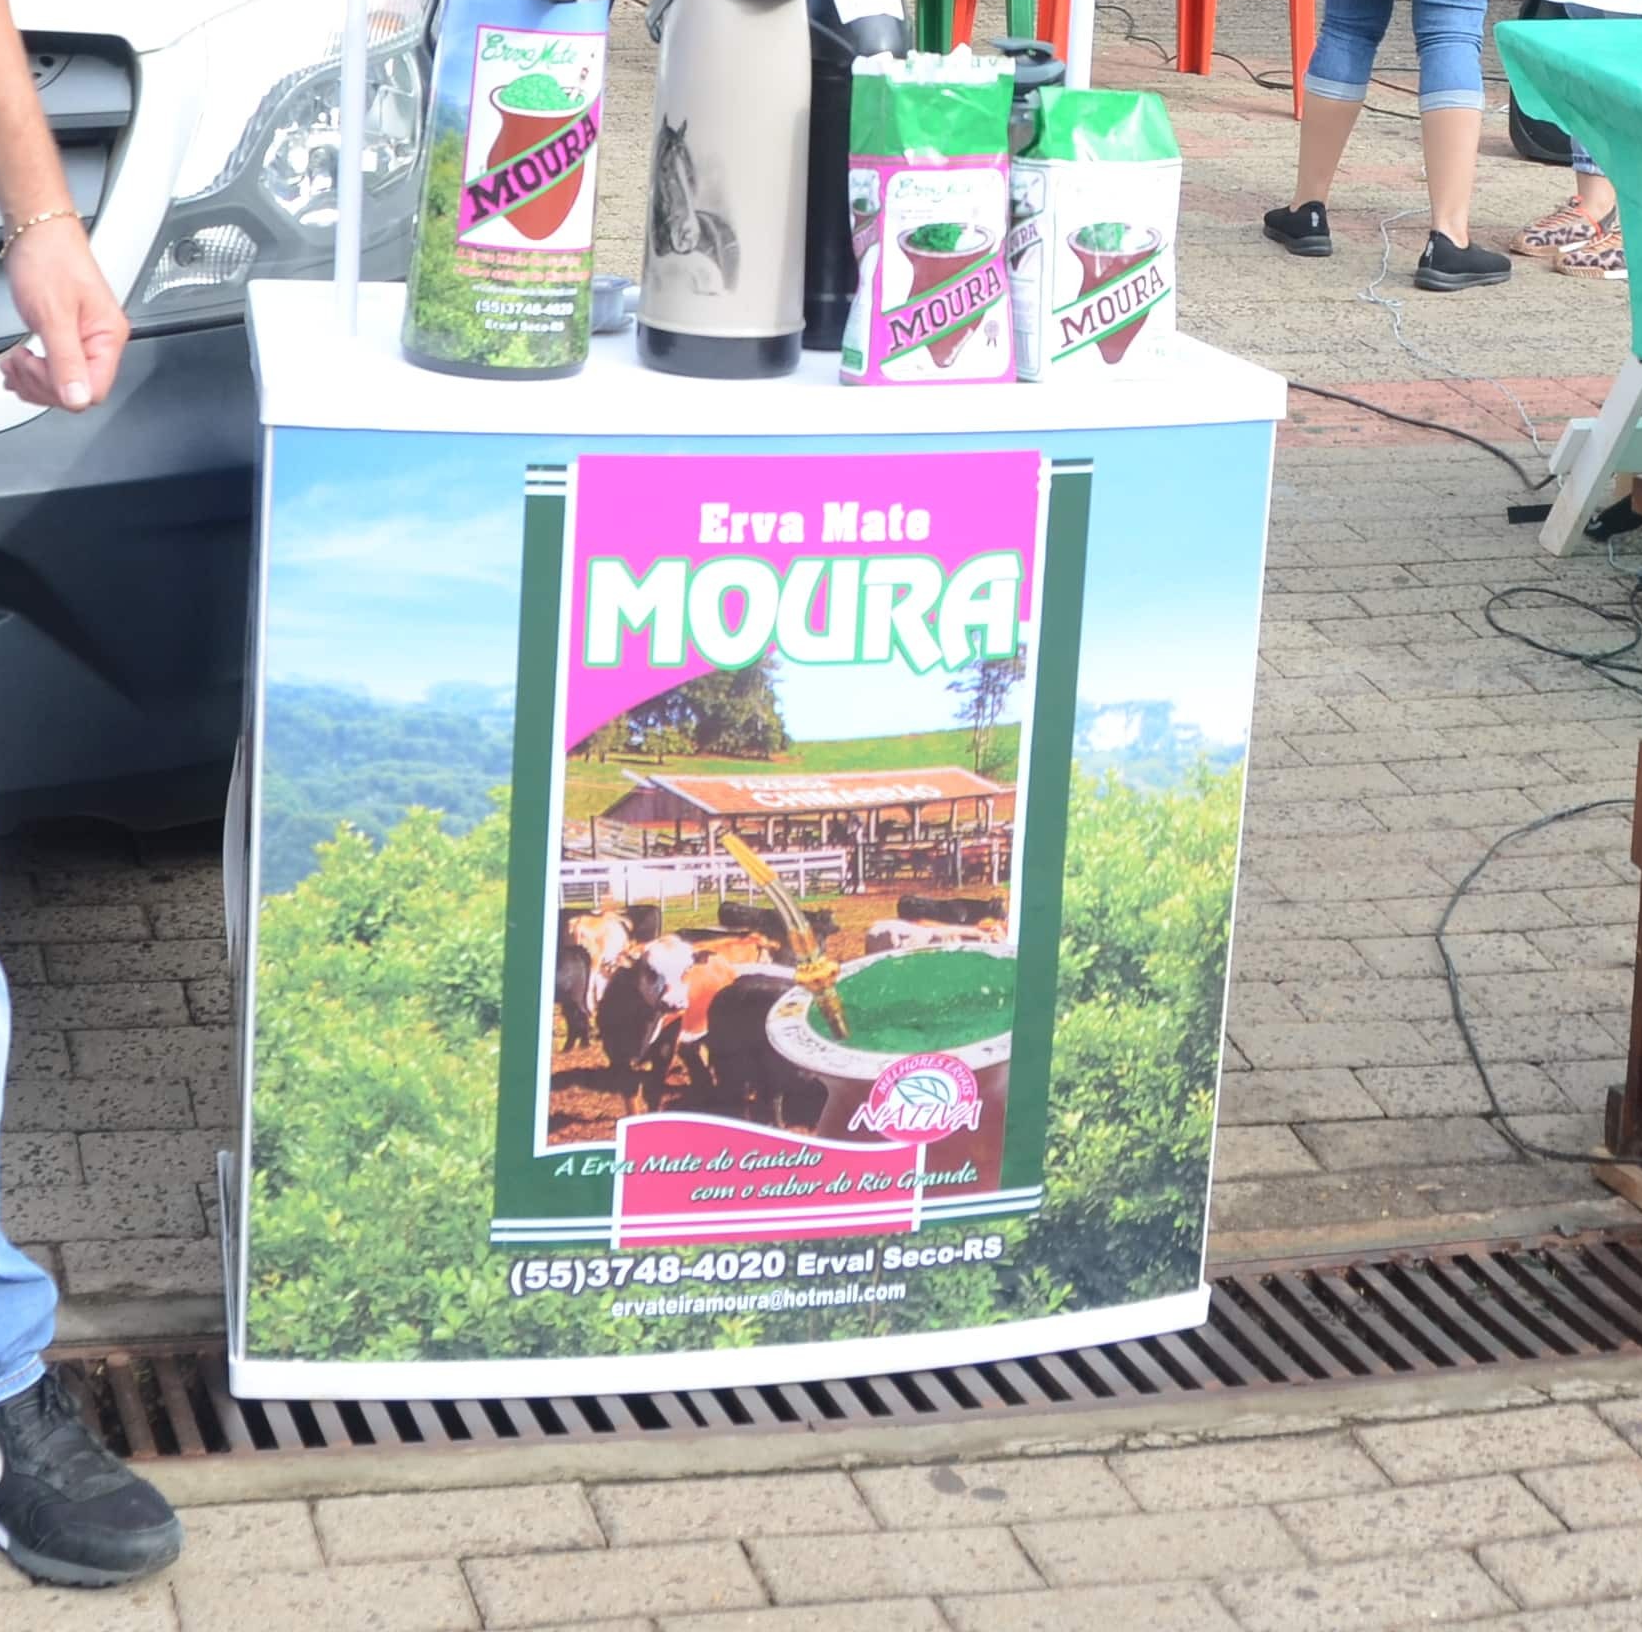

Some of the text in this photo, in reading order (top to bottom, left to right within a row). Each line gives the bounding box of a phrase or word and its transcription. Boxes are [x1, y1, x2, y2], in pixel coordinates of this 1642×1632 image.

[481, 32, 578, 70] Erva Mate
[466, 113, 598, 223] MOURA
[889, 265, 1002, 354] MOURA
[1059, 265, 1165, 348] MOURA
[699, 501, 932, 543] Erva Mate
[583, 549, 1025, 676] MOURA
[878, 1056, 976, 1098] MELHORES ERVAIS
[848, 1099, 983, 1132] NATIVA
[554, 1145, 823, 1177] A Erva Mate do Gaúcho
[690, 1161, 978, 1201] com o sabor do Rio Grande.
[509, 1236, 1004, 1295] (55)3748-4020 Erval Seco-RS
[611, 1280, 906, 1318] ervateiramoura@hotmail.com
